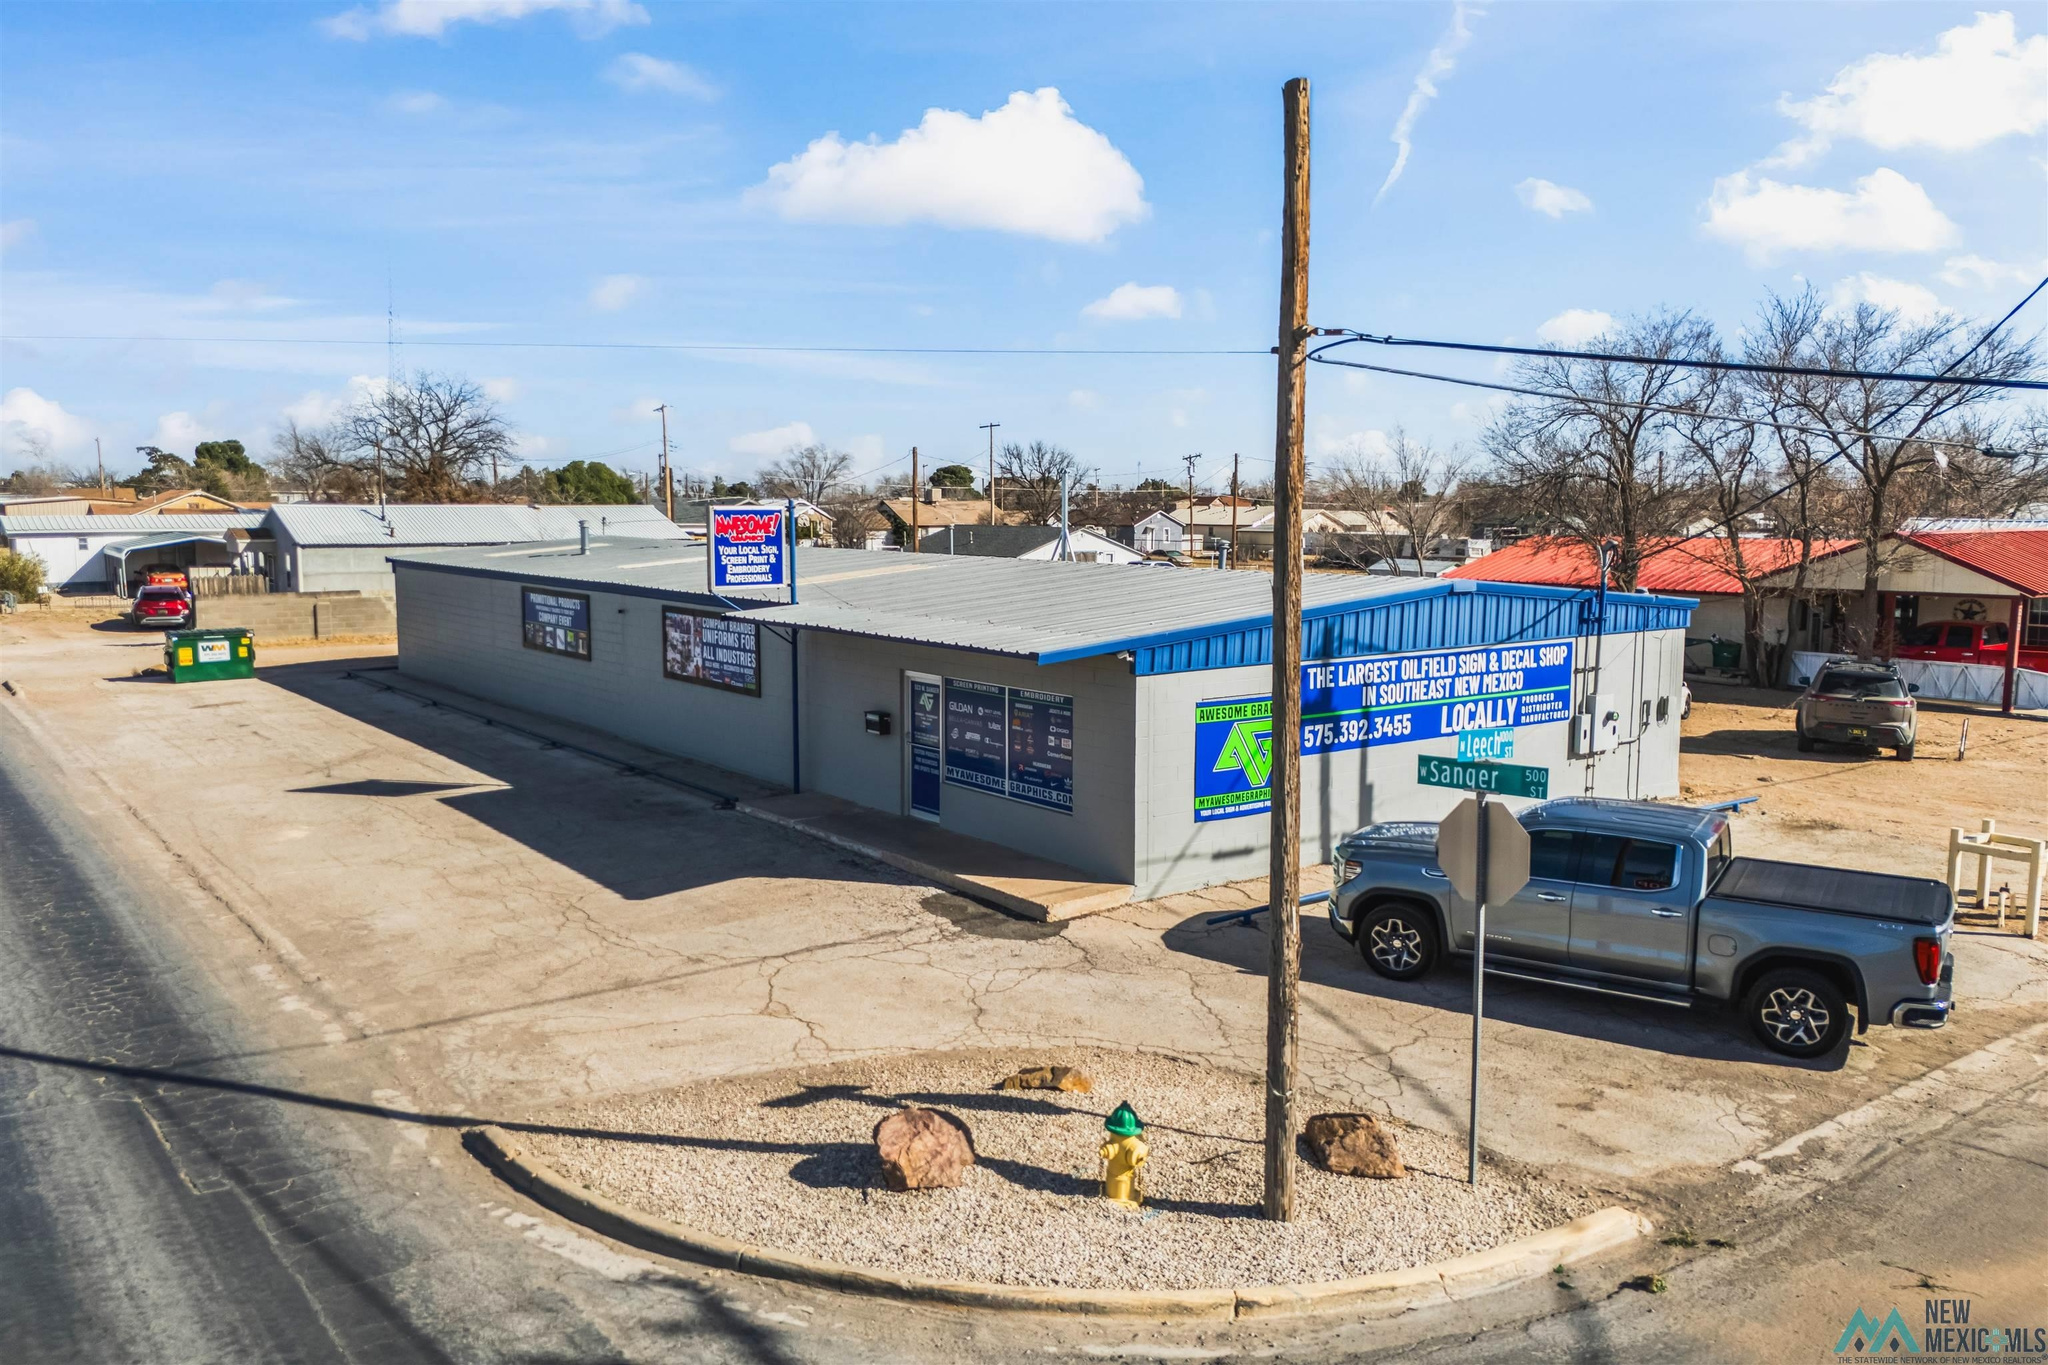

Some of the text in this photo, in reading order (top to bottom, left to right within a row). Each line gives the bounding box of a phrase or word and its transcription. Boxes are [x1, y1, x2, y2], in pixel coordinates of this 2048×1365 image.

[716, 513, 780, 536] AWESOME!
[718, 546, 737, 554] YOUR
[739, 545, 760, 554] LOCAL
[721, 554, 776, 565] SCREEN PRINT &
[728, 565, 770, 574] EMBROIDERY
[726, 574, 772, 583] PROFESSIONALS
[530, 593, 558, 606] PROMOTIONAL
[559, 596, 580, 610] PRODUCTS
[539, 612, 572, 627] COMPANY EVENT
[702, 618, 755, 635] COMPANY BRANDED
[702, 629, 756, 651] UNIFORMS FOR
[703, 645, 756, 668] ALL INDUSTRIES
[1307, 645, 1568, 690] THE LARGEST OILFIELD SIGN & DECAL SHOP
[953, 680, 999, 693] SCREEN PRINTING
[1362, 670, 1524, 706] IN SOUTHEAST NEW MEXICO
[1020, 691, 1064, 703] EMBROIDERY
[1522, 693, 1554, 704] PRODUCED
[949, 701, 974, 714] GILDAN
[1199, 705, 1248, 722] AWESOME
[1441, 697, 1518, 734] LOCALLY
[1521, 701, 1562, 714] DISTRIBUTED
[1521, 710, 1569, 724] MANUFACTURED
[1304, 713, 1412, 748] 575.392.3455
[1460, 741, 1465, 752] N
[1467, 731, 1500, 757] Leech
[1505, 746, 1513, 758] ST
[946, 766, 1005, 789] MYAWESOME
[1420, 760, 1546, 789] W Sanger 500
[1530, 786, 1543, 798] ST
